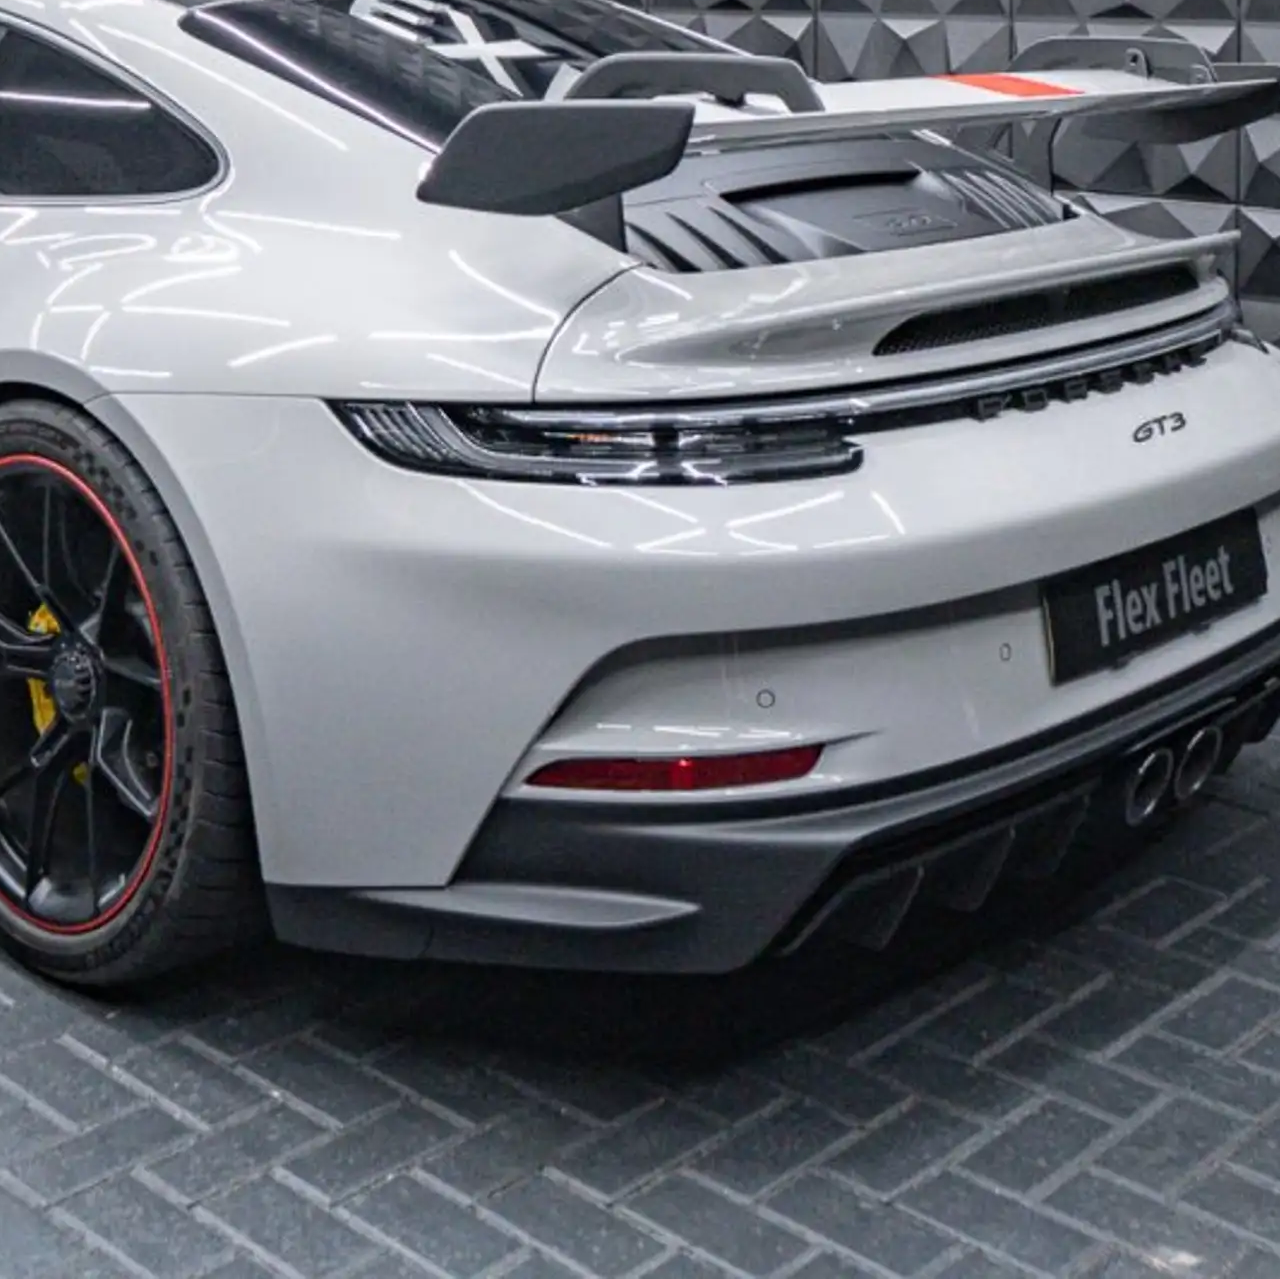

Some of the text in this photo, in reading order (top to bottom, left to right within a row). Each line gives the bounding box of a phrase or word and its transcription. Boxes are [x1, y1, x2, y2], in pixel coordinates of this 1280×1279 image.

[1132, 411, 1188, 444] GT3
[1094, 544, 1235, 648] Flex Fleet
